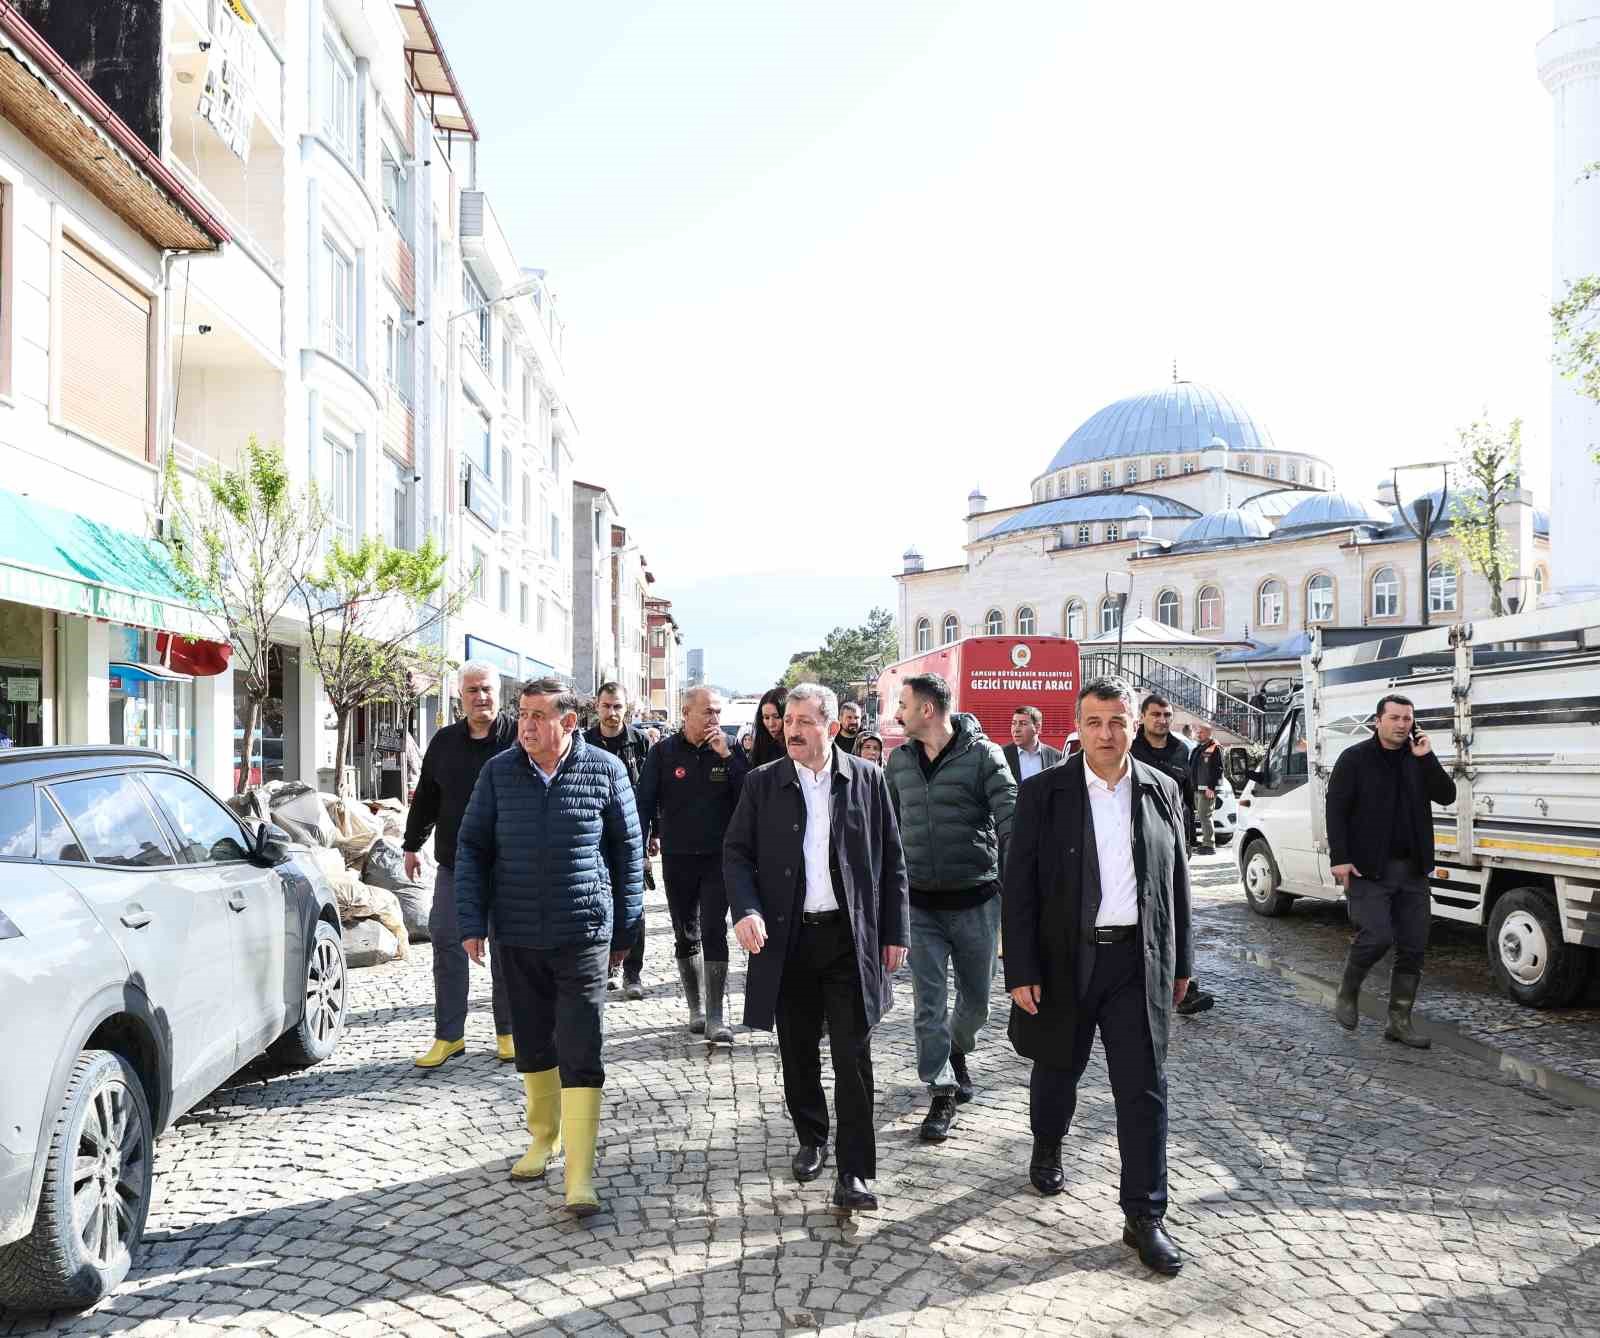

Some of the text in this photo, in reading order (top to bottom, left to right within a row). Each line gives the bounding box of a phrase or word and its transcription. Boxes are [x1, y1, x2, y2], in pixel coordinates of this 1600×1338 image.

[971, 678, 1072, 690] GEZİCİ TUVALET ARACI
